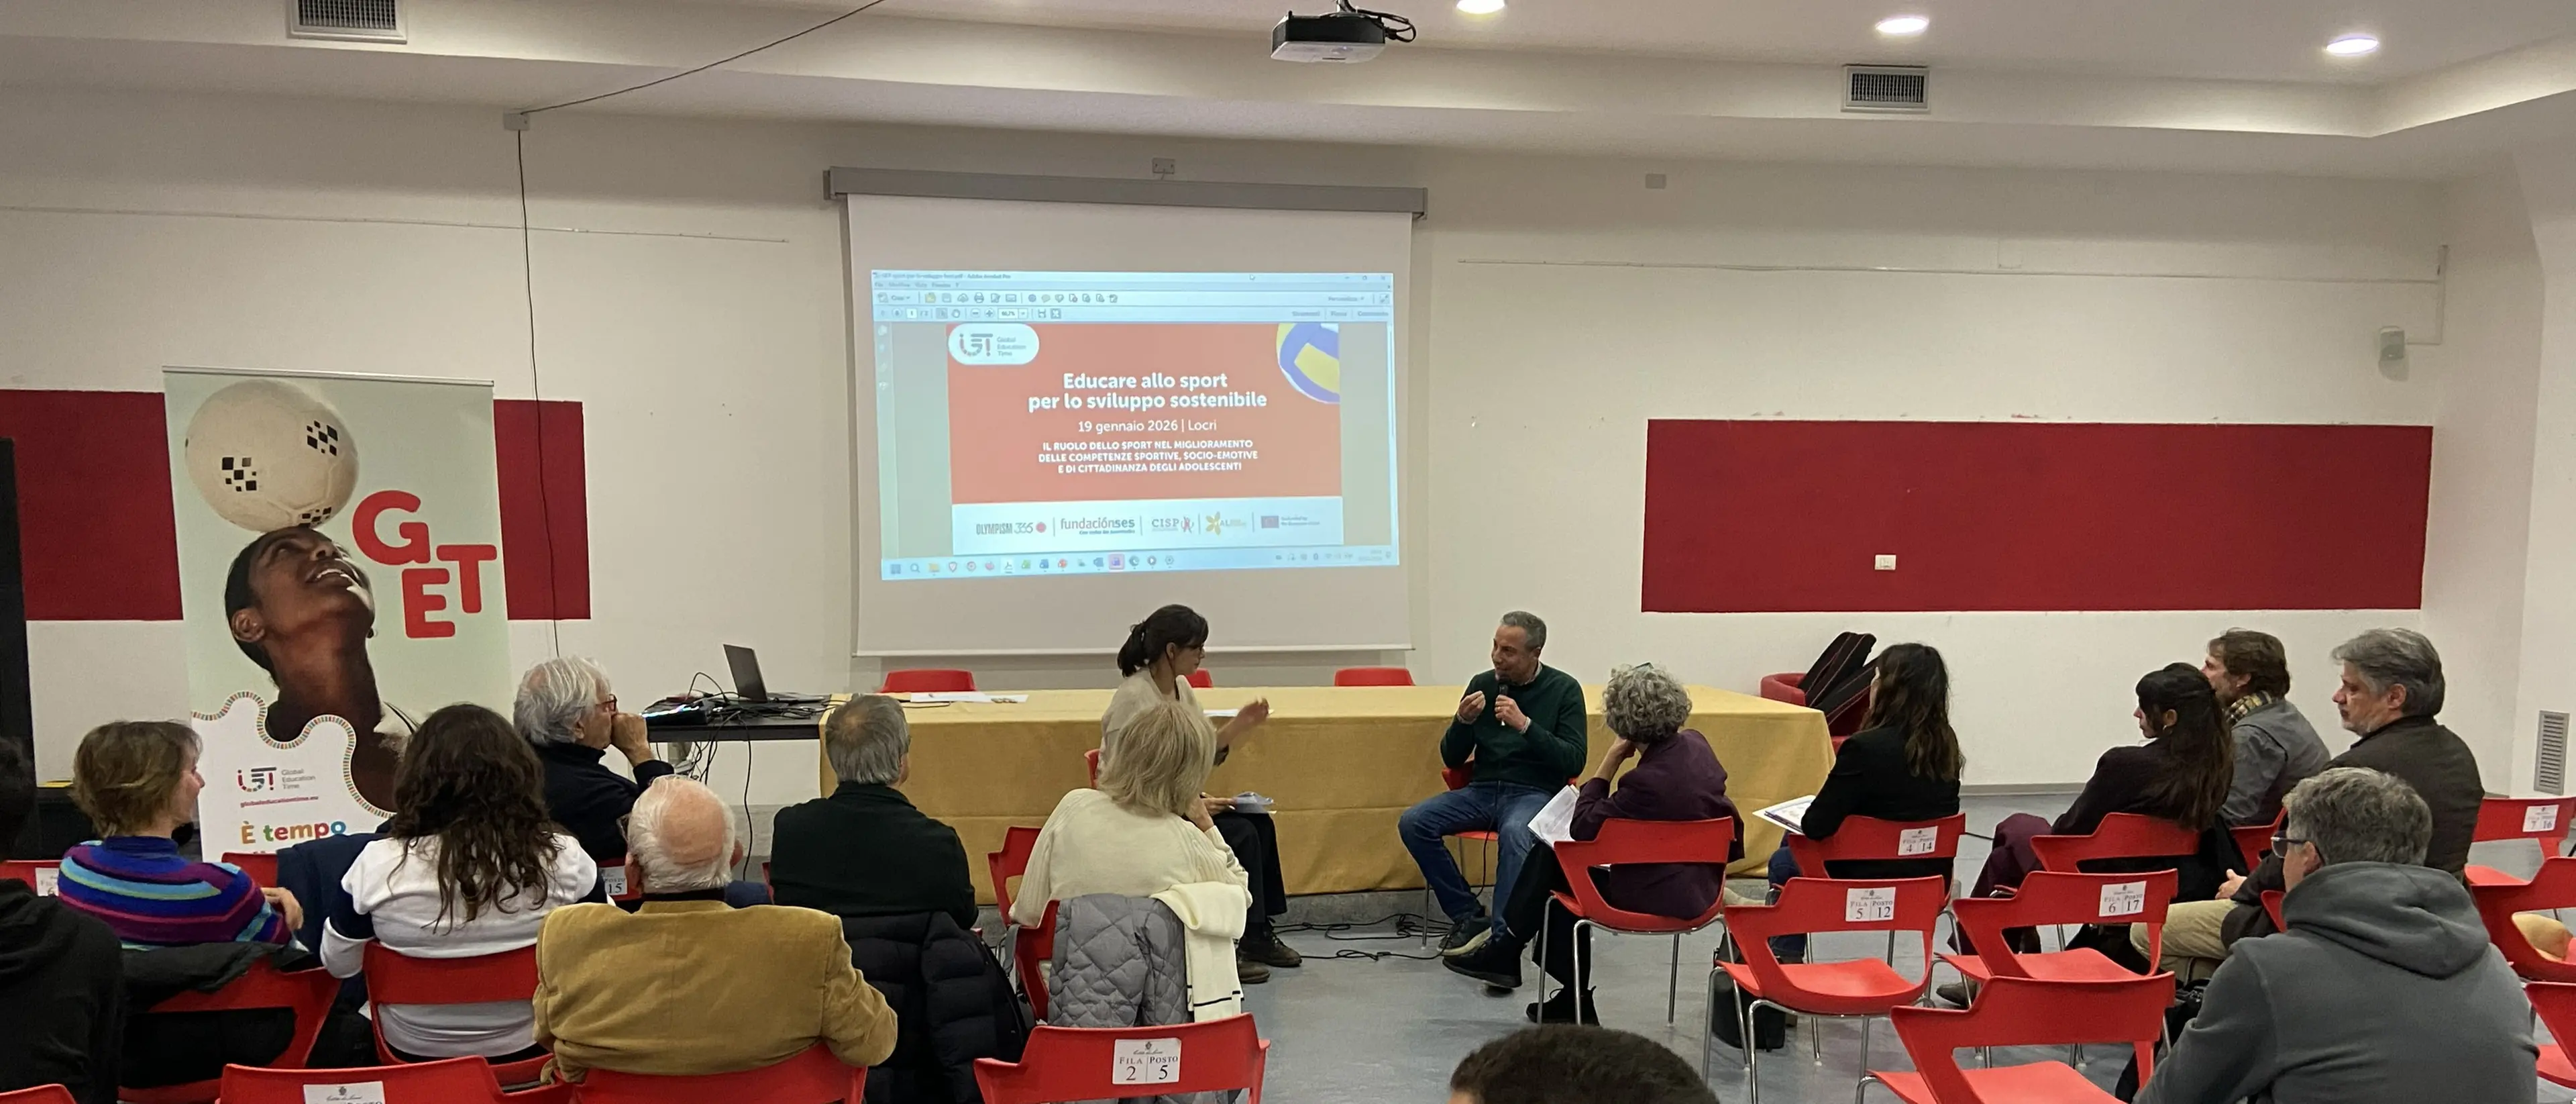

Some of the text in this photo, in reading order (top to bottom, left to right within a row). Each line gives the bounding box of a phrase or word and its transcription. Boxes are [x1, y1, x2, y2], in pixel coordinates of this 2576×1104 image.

[1063, 372, 1228, 392] Educare allo sport
[1028, 391, 1267, 413] per lo sviluppo sostenibile
[1078, 419, 1217, 434] 19 gennaio 2026 Locri
[1042, 440, 1253, 451] IL RUOLO DELLO SPORT NEL MIGLIORAMENTO
[1038, 450, 1258, 462] DELLE COMPETENZE SPORTIVE, SOCIO-EMOTIVE
[1058, 462, 1242, 473] E DI CITTADINANZA DEGLI ADOLESCENTI
[975, 522, 1013, 536] OLYMPISM
[1152, 518, 1179, 528] CISP
[282, 775, 316, 783] Education
[241, 820, 347, 844] È tempo
[1907, 842, 1932, 852] 4 14
[609, 883, 622, 893] 15
[2108, 899, 2140, 913] 6 17
[1856, 906, 1890, 919] 5 12
[1119, 1056, 1178, 1064] FILA POSTO
[1126, 1064, 1169, 1081] 2 5
